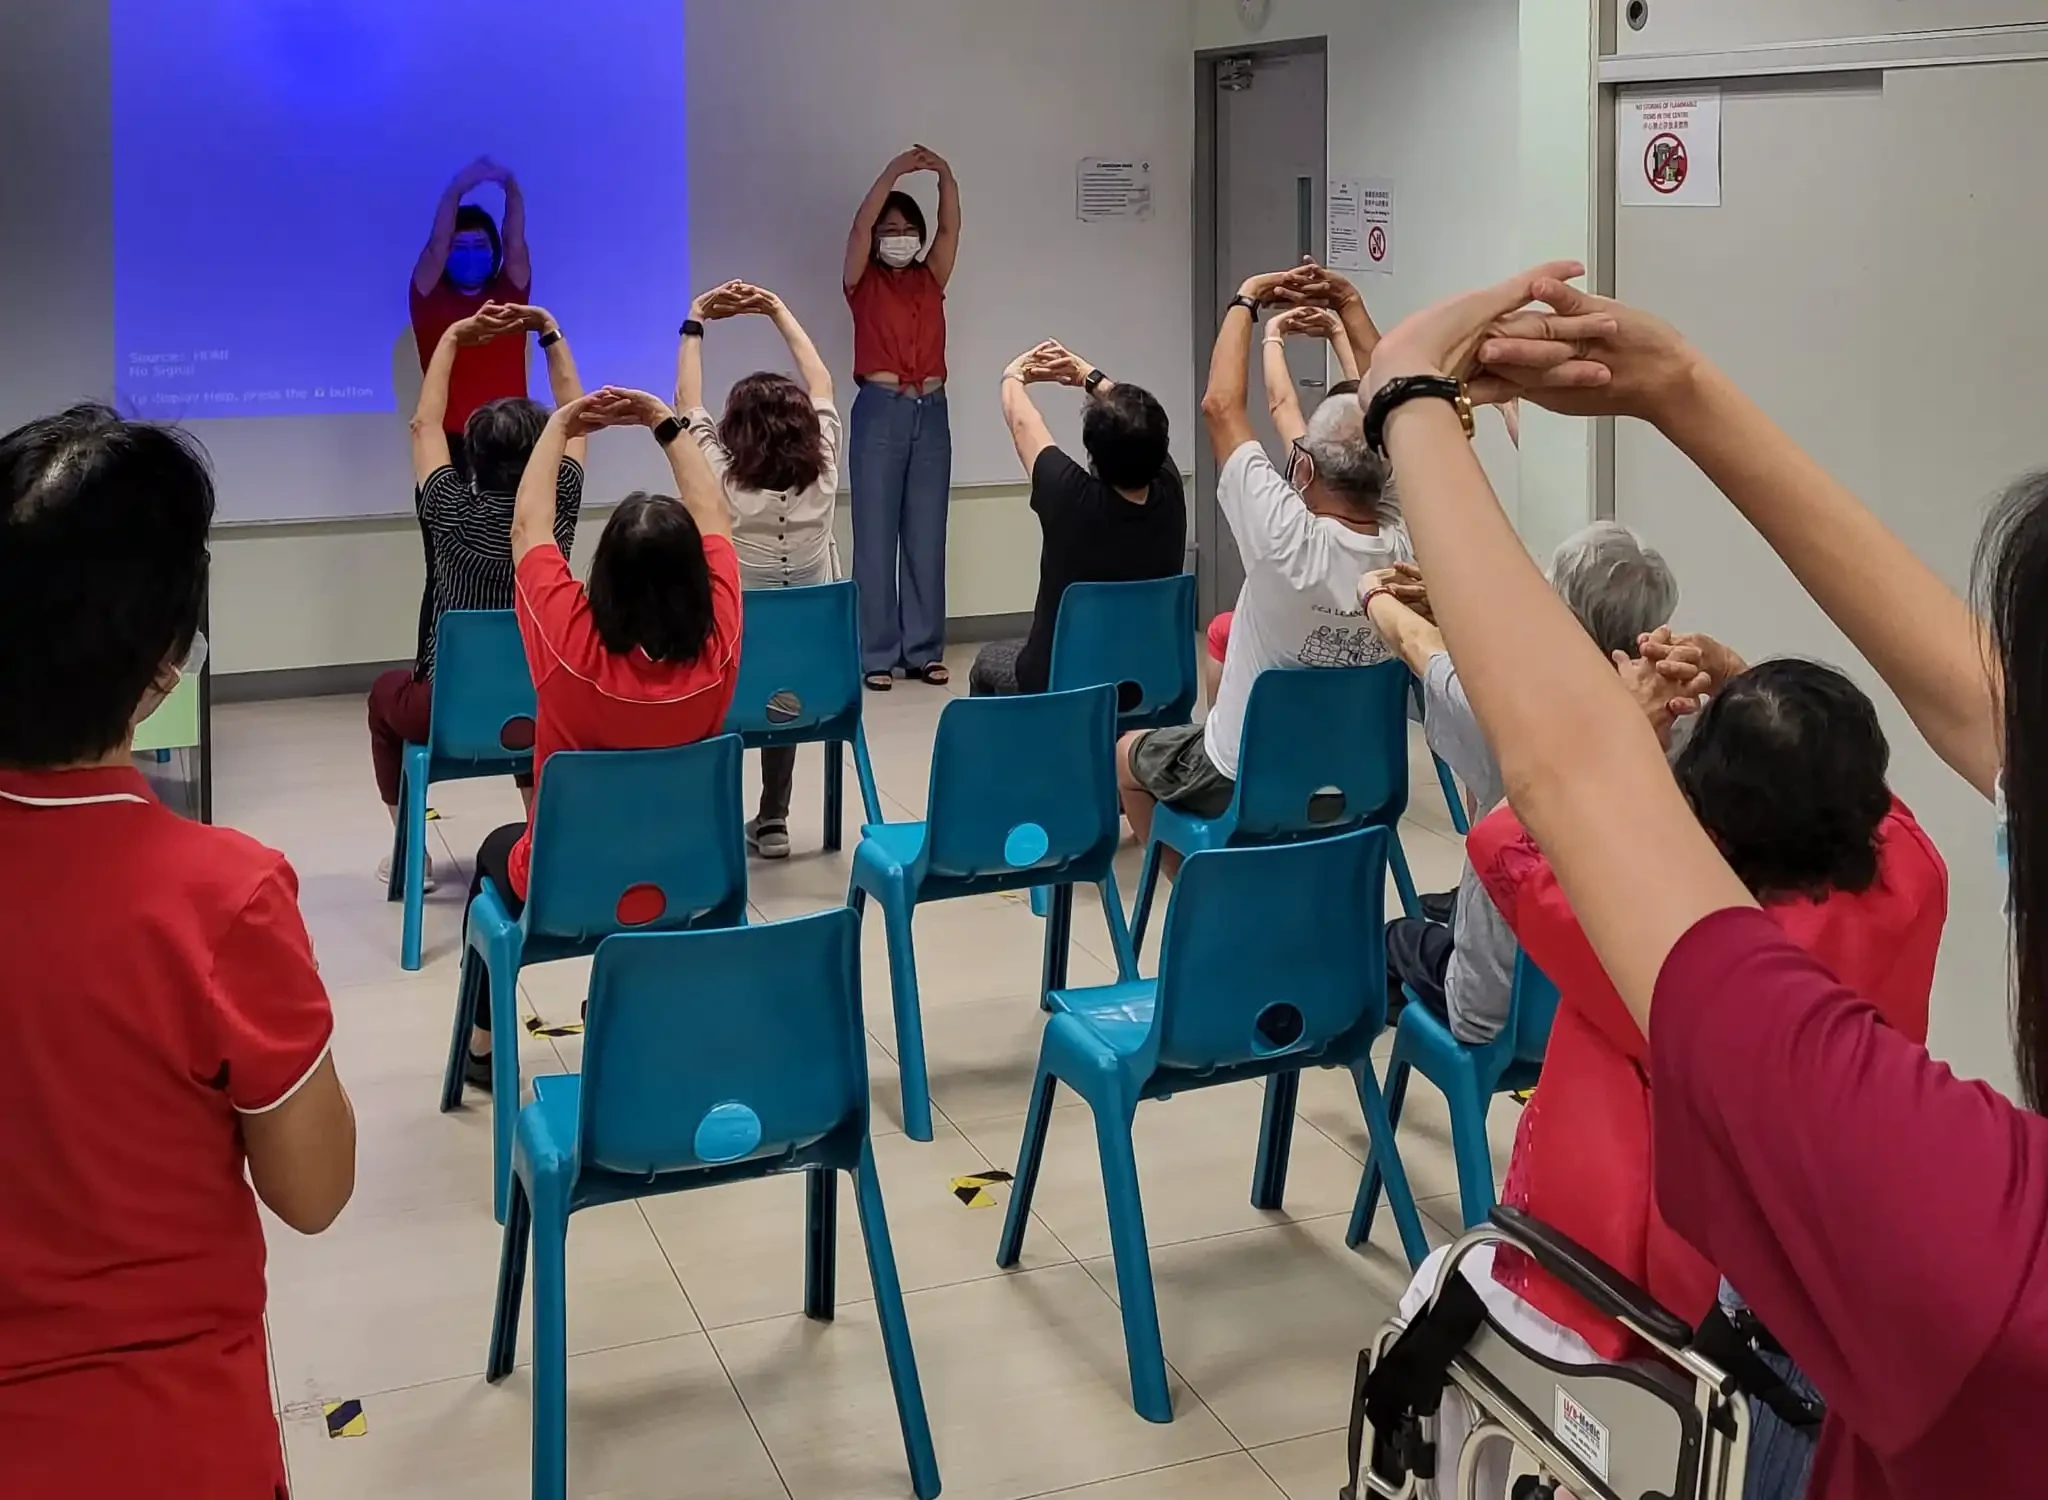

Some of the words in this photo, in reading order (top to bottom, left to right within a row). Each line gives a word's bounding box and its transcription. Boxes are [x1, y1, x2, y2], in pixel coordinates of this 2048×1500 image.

[130, 351, 185, 363] Source:
[129, 366, 148, 377] No
[154, 364, 195, 377] Signal
[285, 388, 307, 399] the
[329, 386, 373, 398] button
